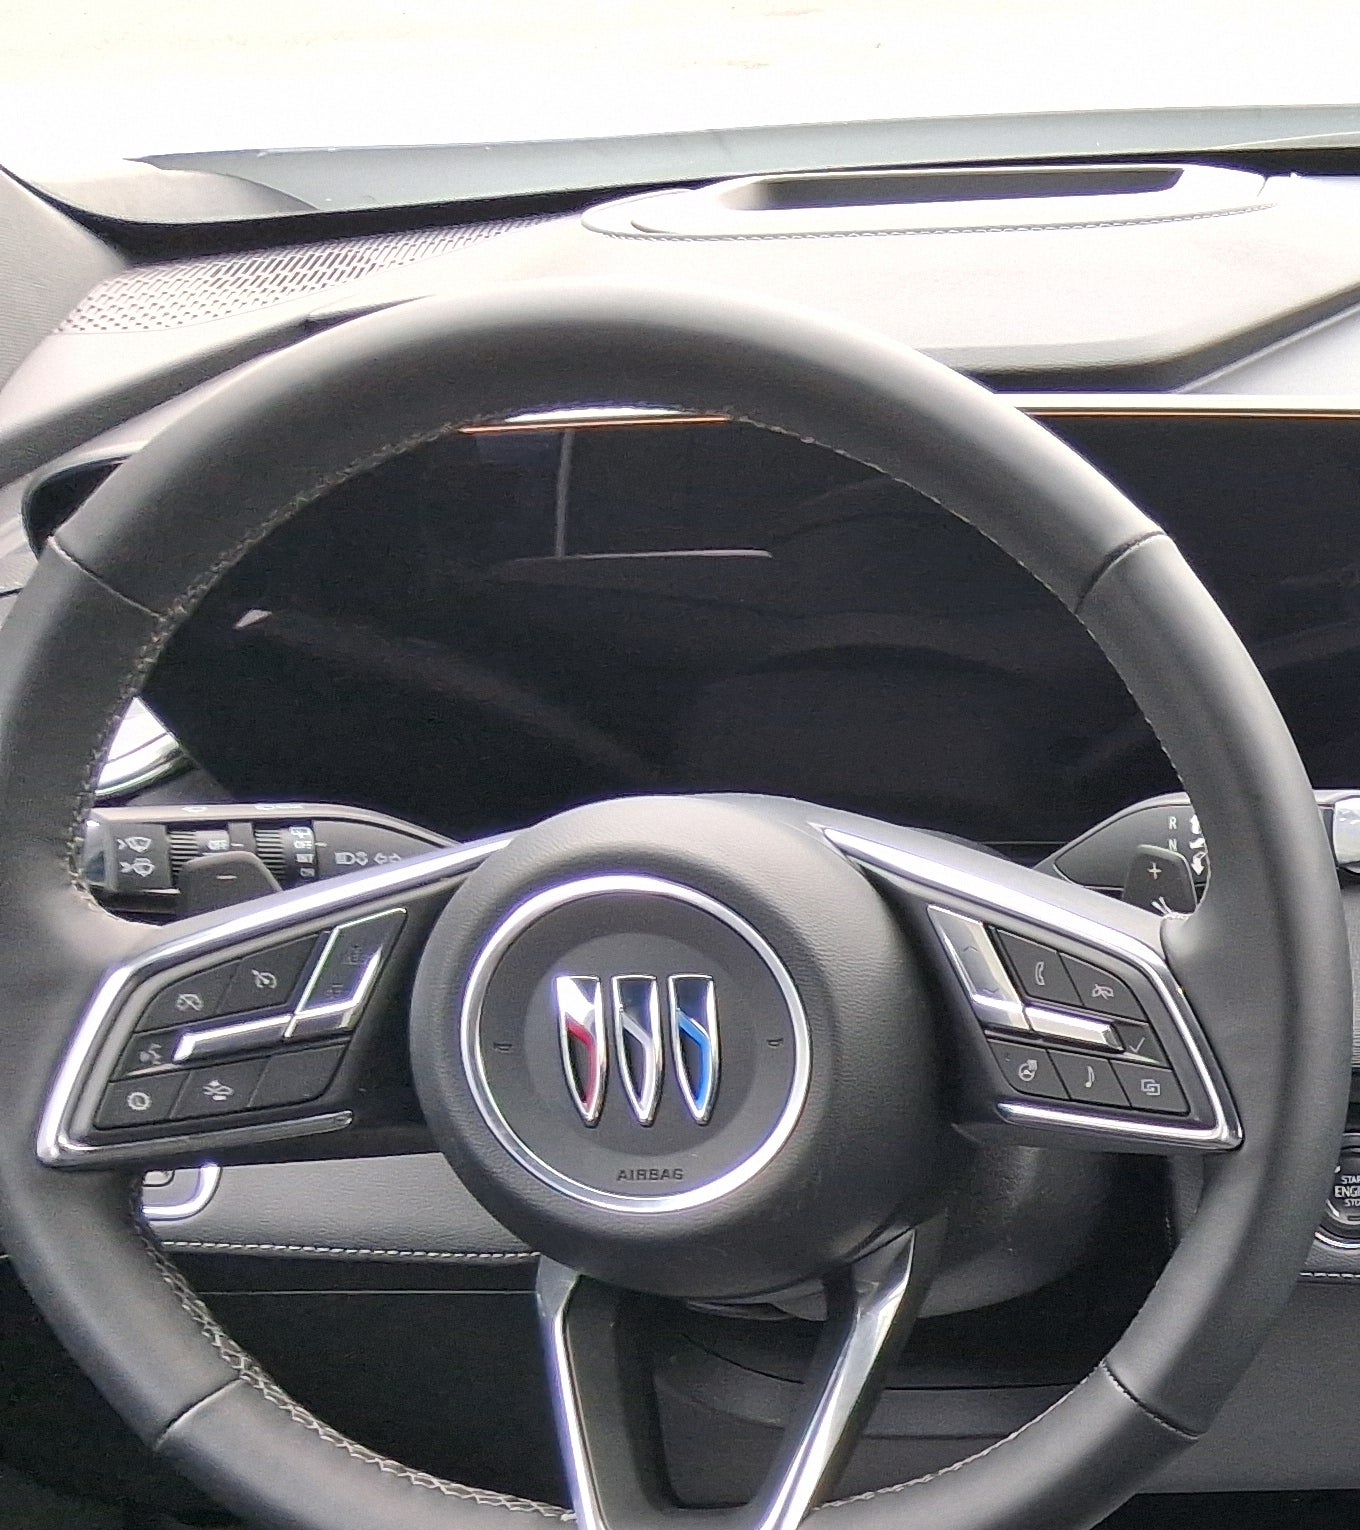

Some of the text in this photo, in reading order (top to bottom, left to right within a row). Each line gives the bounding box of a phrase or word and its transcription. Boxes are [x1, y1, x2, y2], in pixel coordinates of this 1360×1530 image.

[1169, 815, 1178, 830] R
[1169, 838, 1178, 852] N
[616, 1168, 684, 1181] AIRBAG
